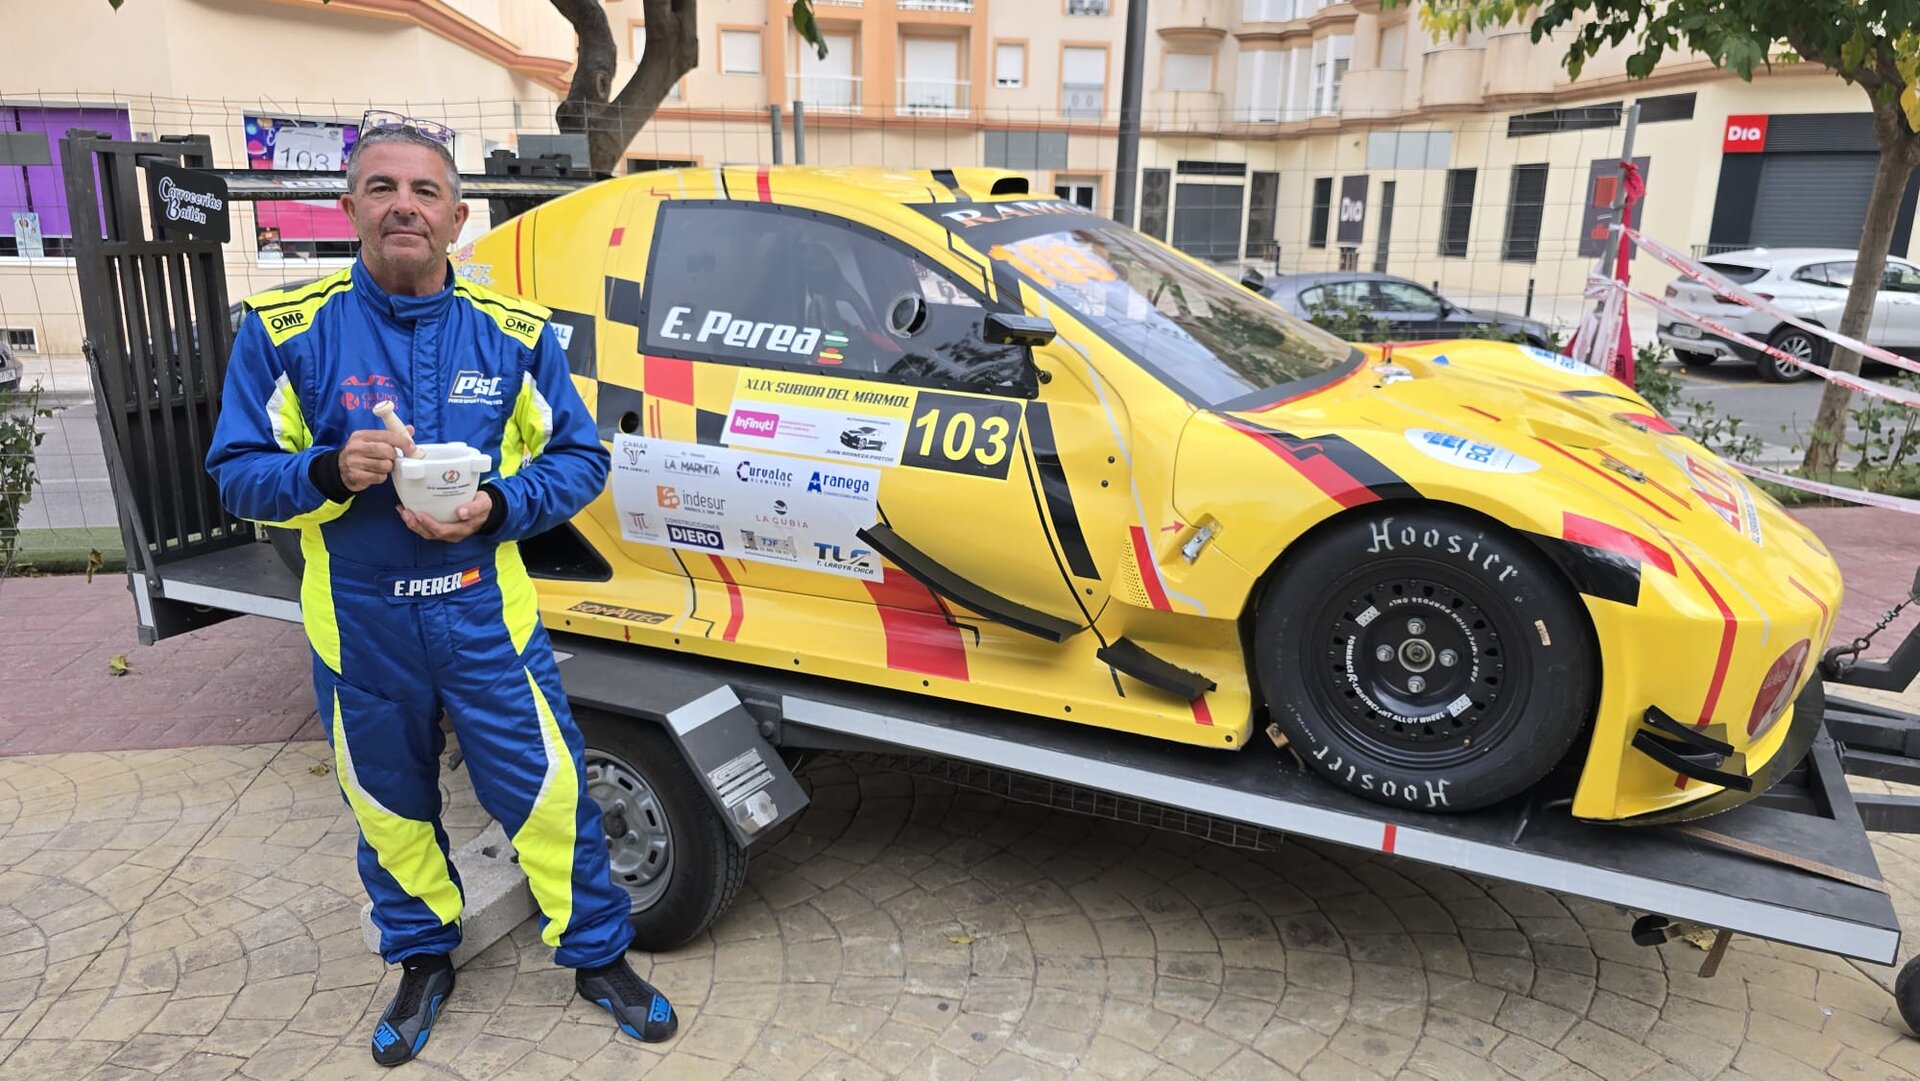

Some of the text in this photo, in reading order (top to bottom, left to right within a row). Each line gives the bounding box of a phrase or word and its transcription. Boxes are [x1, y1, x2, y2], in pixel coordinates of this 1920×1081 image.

[1727, 126, 1761, 141] Dia
[280, 147, 329, 170] 103
[158, 176, 222, 211] Carrocerías
[166, 196, 206, 225] Bailén
[1341, 196, 1363, 222] Dia
[271, 312, 304, 329] OMP
[505, 317, 535, 334] OMP
[660, 306, 822, 355] E. Perea
[744, 378, 774, 392] XLIX
[775, 382, 827, 398] SUBIDA
[827, 388, 850, 402] DEL
[915, 408, 1010, 466] 103
[665, 459, 720, 476] LA MARMITA
[736, 460, 793, 482] Curvalac
[807, 471, 870, 495] Aranega
[682, 490, 726, 510] indesur
[755, 514, 769, 522] LA
[671, 527, 720, 546] DIERO
[1451, 613, 1479, 664] CMPETITION
[1392, 714, 1419, 724] ALLOY
[1419, 711, 1446, 724] WHEEL
